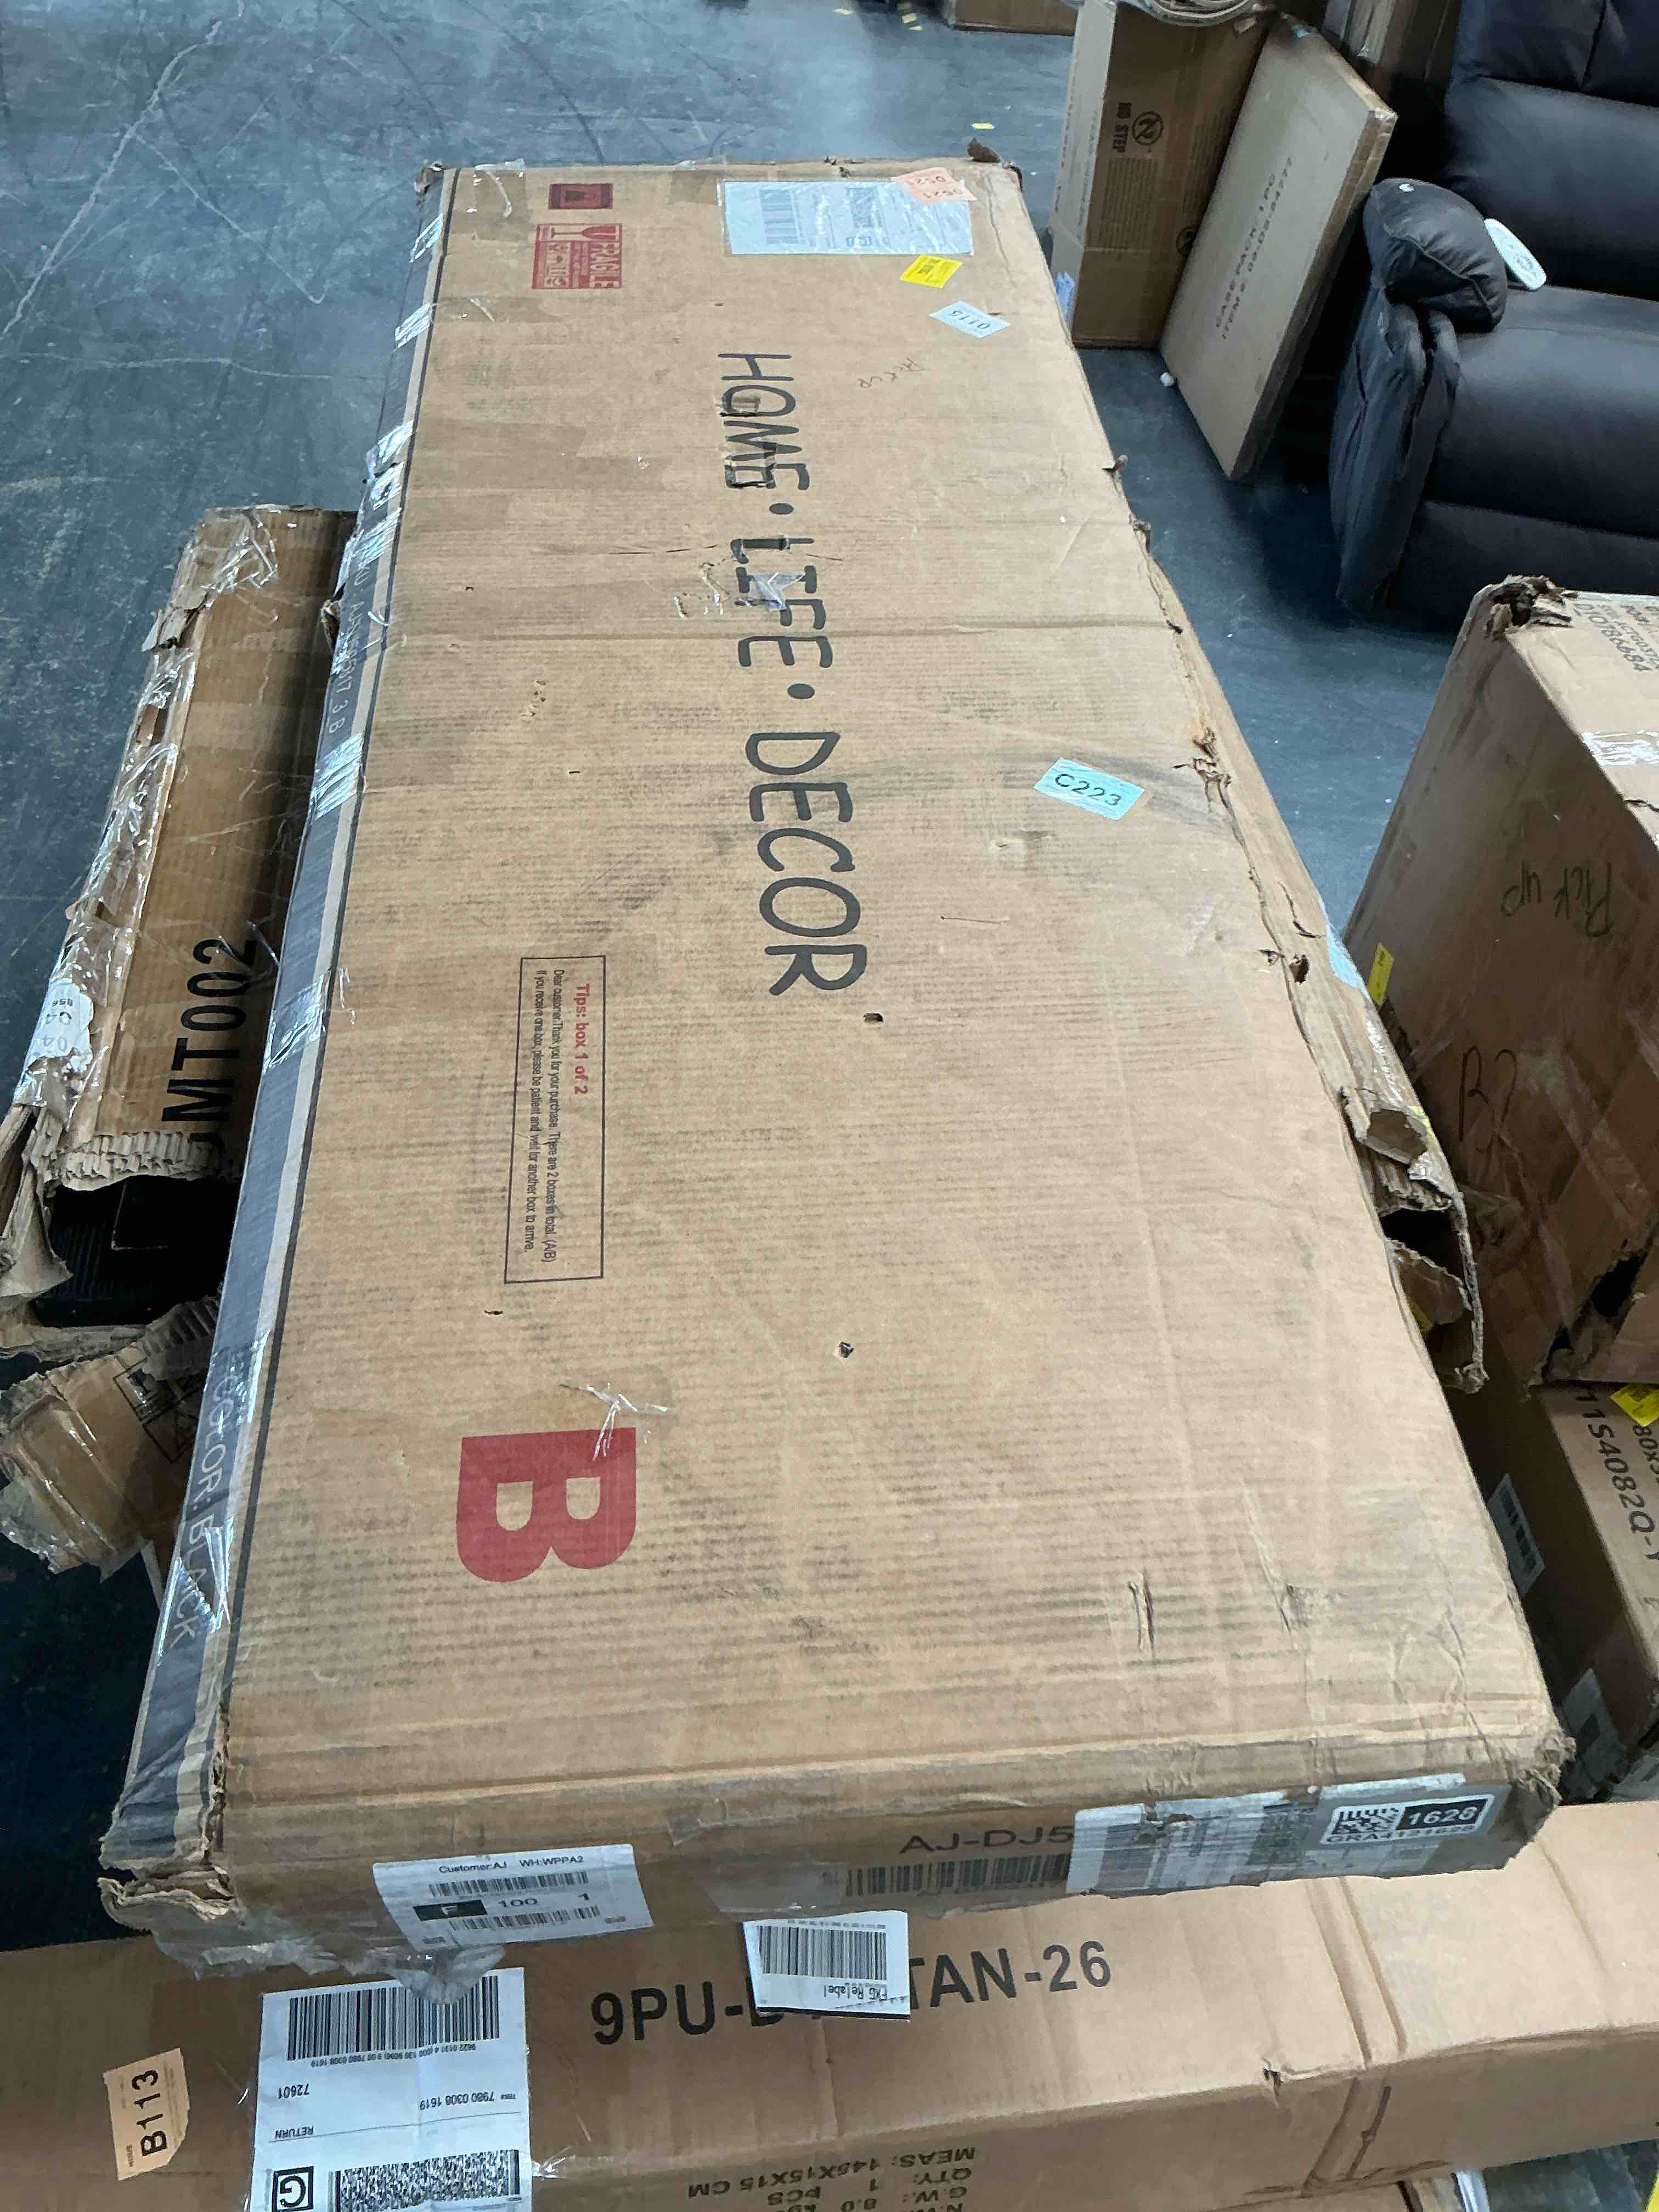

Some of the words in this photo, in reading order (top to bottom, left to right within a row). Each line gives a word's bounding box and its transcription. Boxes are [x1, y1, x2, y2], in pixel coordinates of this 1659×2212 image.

[1113, 125, 1128, 153] STEP
[589, 242, 620, 289] FRAGILE
[731, 534, 833, 669] LIFE
[1055, 774, 1121, 806] C223
[746, 731, 868, 996] DECOR
[534, 977, 545, 989] you
[552, 969, 565, 987] Dear
[534, 990, 545, 1016] receive
[573, 984, 590, 1018] Tips:
[575, 1023, 589, 1048] box
[531, 1050, 545, 1075] please
[549, 1046, 560, 1059] you
[550, 1061, 562, 1070] for
[575, 1065, 589, 1081] of
[532, 1076, 544, 1087] be
[548, 1070, 560, 1090] your
[574, 1086, 589, 1095] 2
[529, 1088, 544, 1114] patient
[548, 1091, 561, 1131] purchase.
[530, 1115, 541, 1132] and
[548, 1132, 561, 1157] There
[528, 1152, 540, 1161] for
[548, 1158, 557, 1171] are
[526, 1163, 540, 1195] another
[545, 1180, 559, 1204] boxes
[526, 1197, 539, 1213] box
[526, 1215, 536, 1223] to
[524, 1224, 537, 1252] arrive.
[540, 1239, 557, 1263] (A/B)
[193, 1378, 235, 1511] COLOR:
[456, 1426, 637, 1583] B
[170, 1512, 214, 1649] BLACK
[498, 1897, 539, 1908] 100
[578, 1892, 591, 1901] 1
[823, 1984, 864, 2000] Relabel
[278, 2083, 310, 2100] 72601
[445, 2094, 469, 2106] 0308
[471, 2091, 495, 2103] 7980
[131, 2069, 167, 2156] B113
[420, 2097, 442, 2111] 1619
[274, 2125, 314, 2140] RETURN
[891, 2147, 975, 2167] MEAS:
[869, 2179, 879, 2192] 1
[912, 2168, 972, 2186] QTY:
[279, 2175, 307, 2209] G
[687, 2181, 731, 2199] CM
